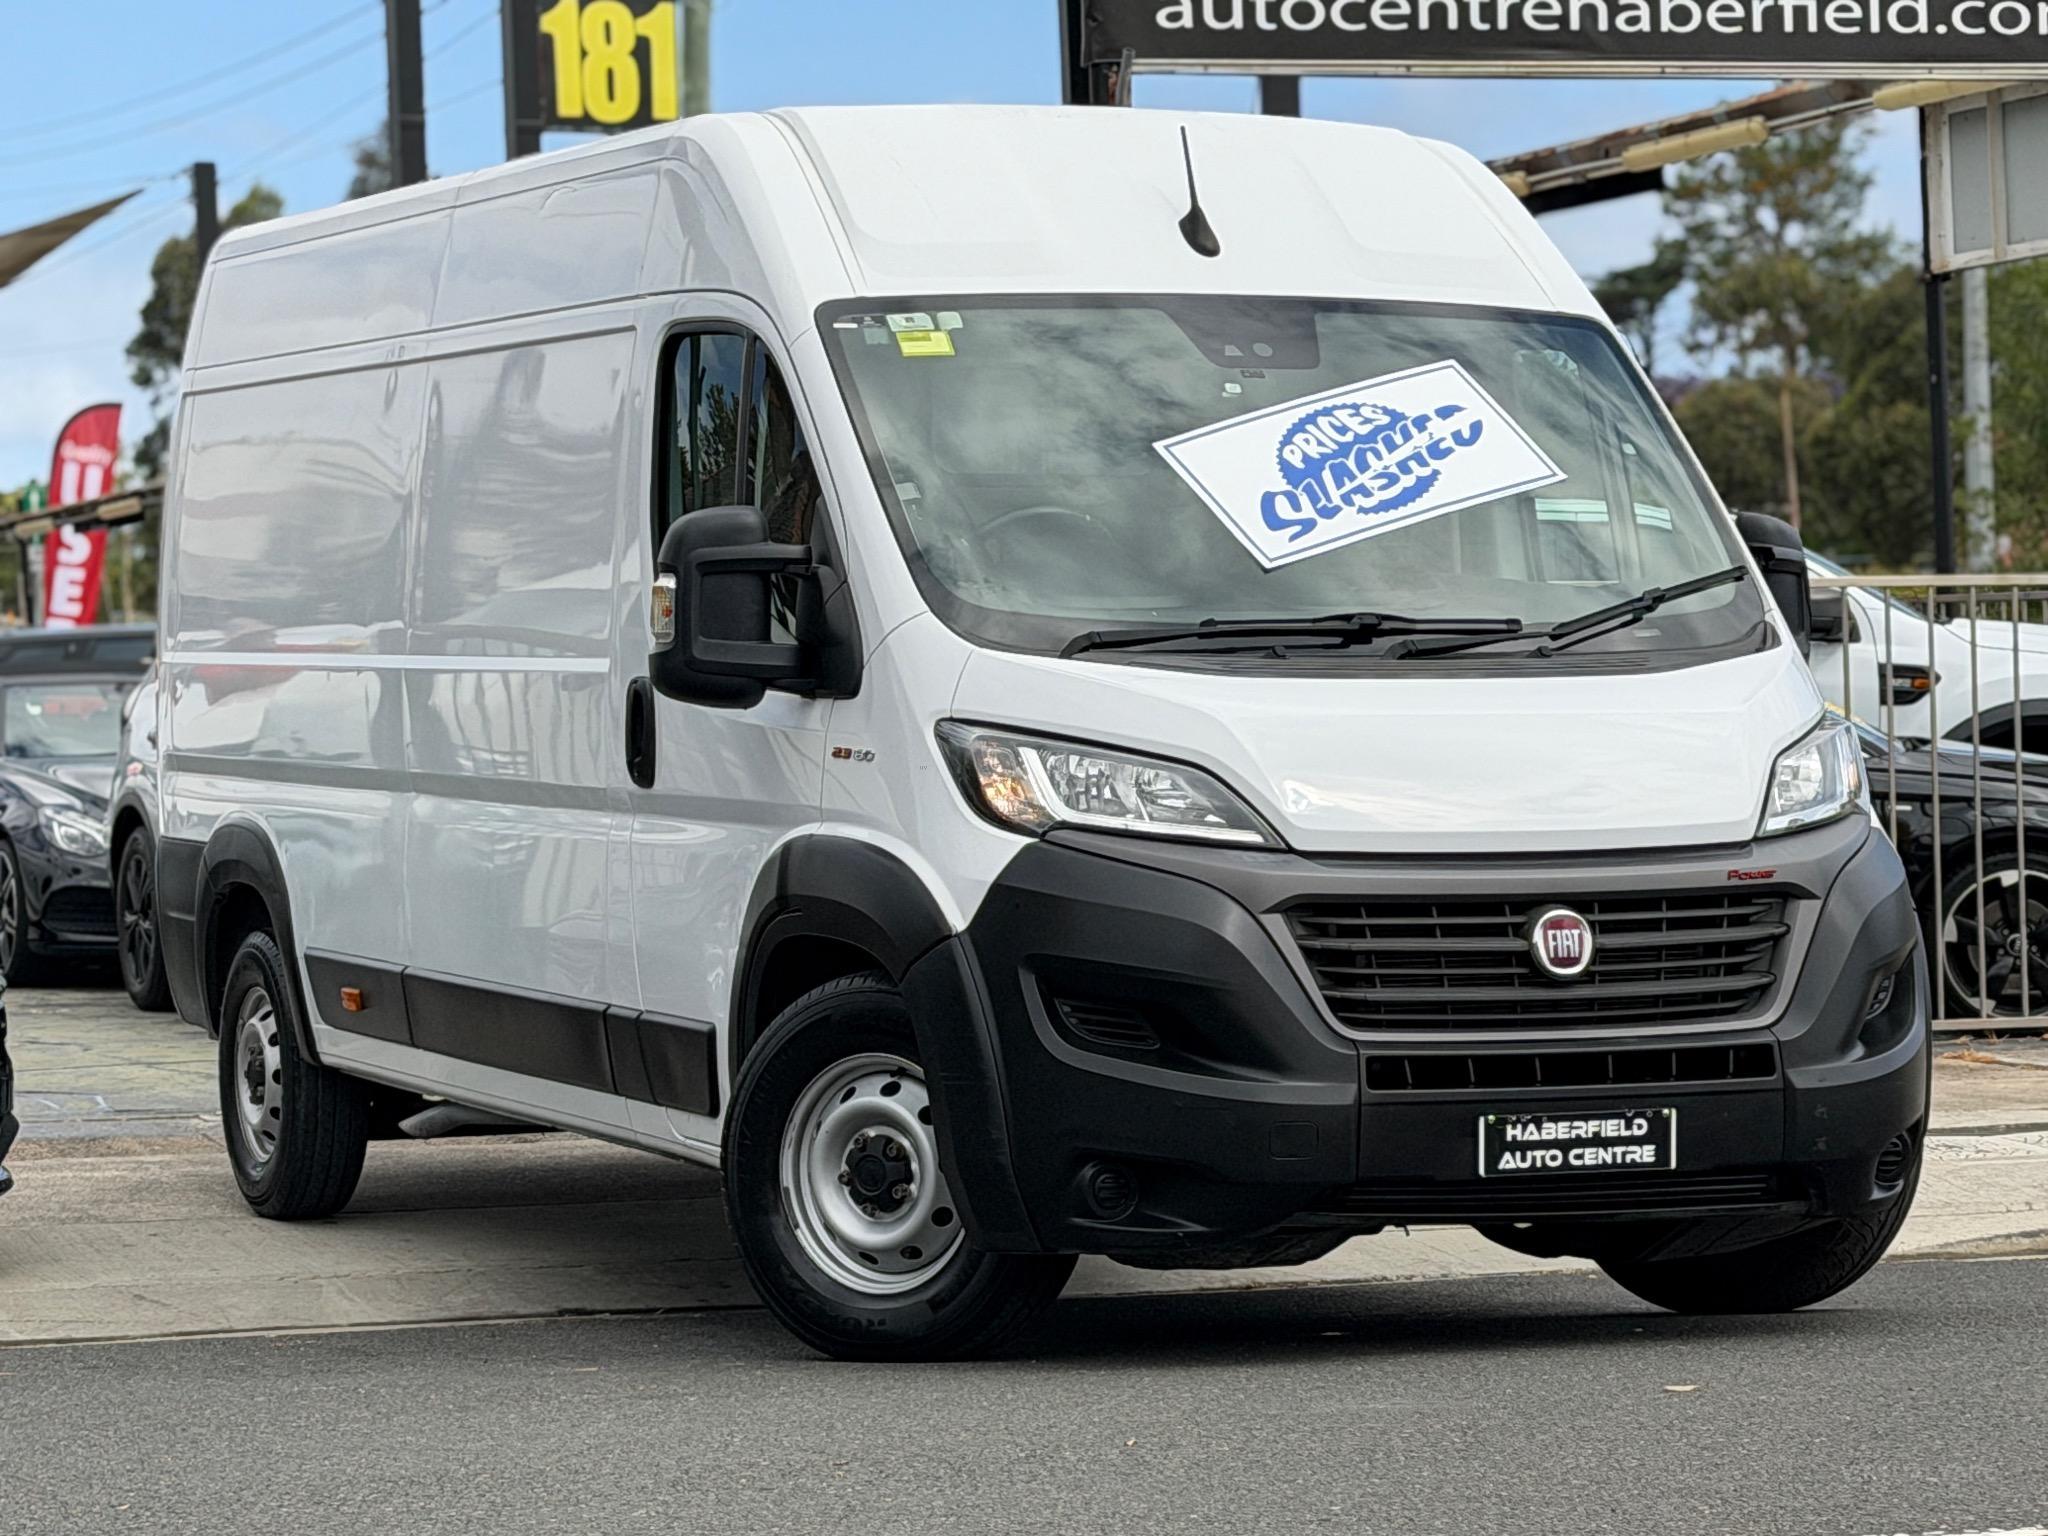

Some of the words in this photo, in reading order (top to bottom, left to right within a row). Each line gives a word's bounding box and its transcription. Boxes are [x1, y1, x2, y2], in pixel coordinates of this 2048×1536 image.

[1155, 0, 2048, 35] autocentrehaberfield.co
[540, 0, 678, 124] 181
[1282, 404, 1391, 469] PRICES
[45, 460, 104, 629] USE
[1547, 929, 1581, 958] FIAT
[1506, 1118, 1648, 1141] HABERFIELD
[1497, 1150, 1562, 1169] AUTO
[1568, 1145, 1656, 1165] CENTRE
